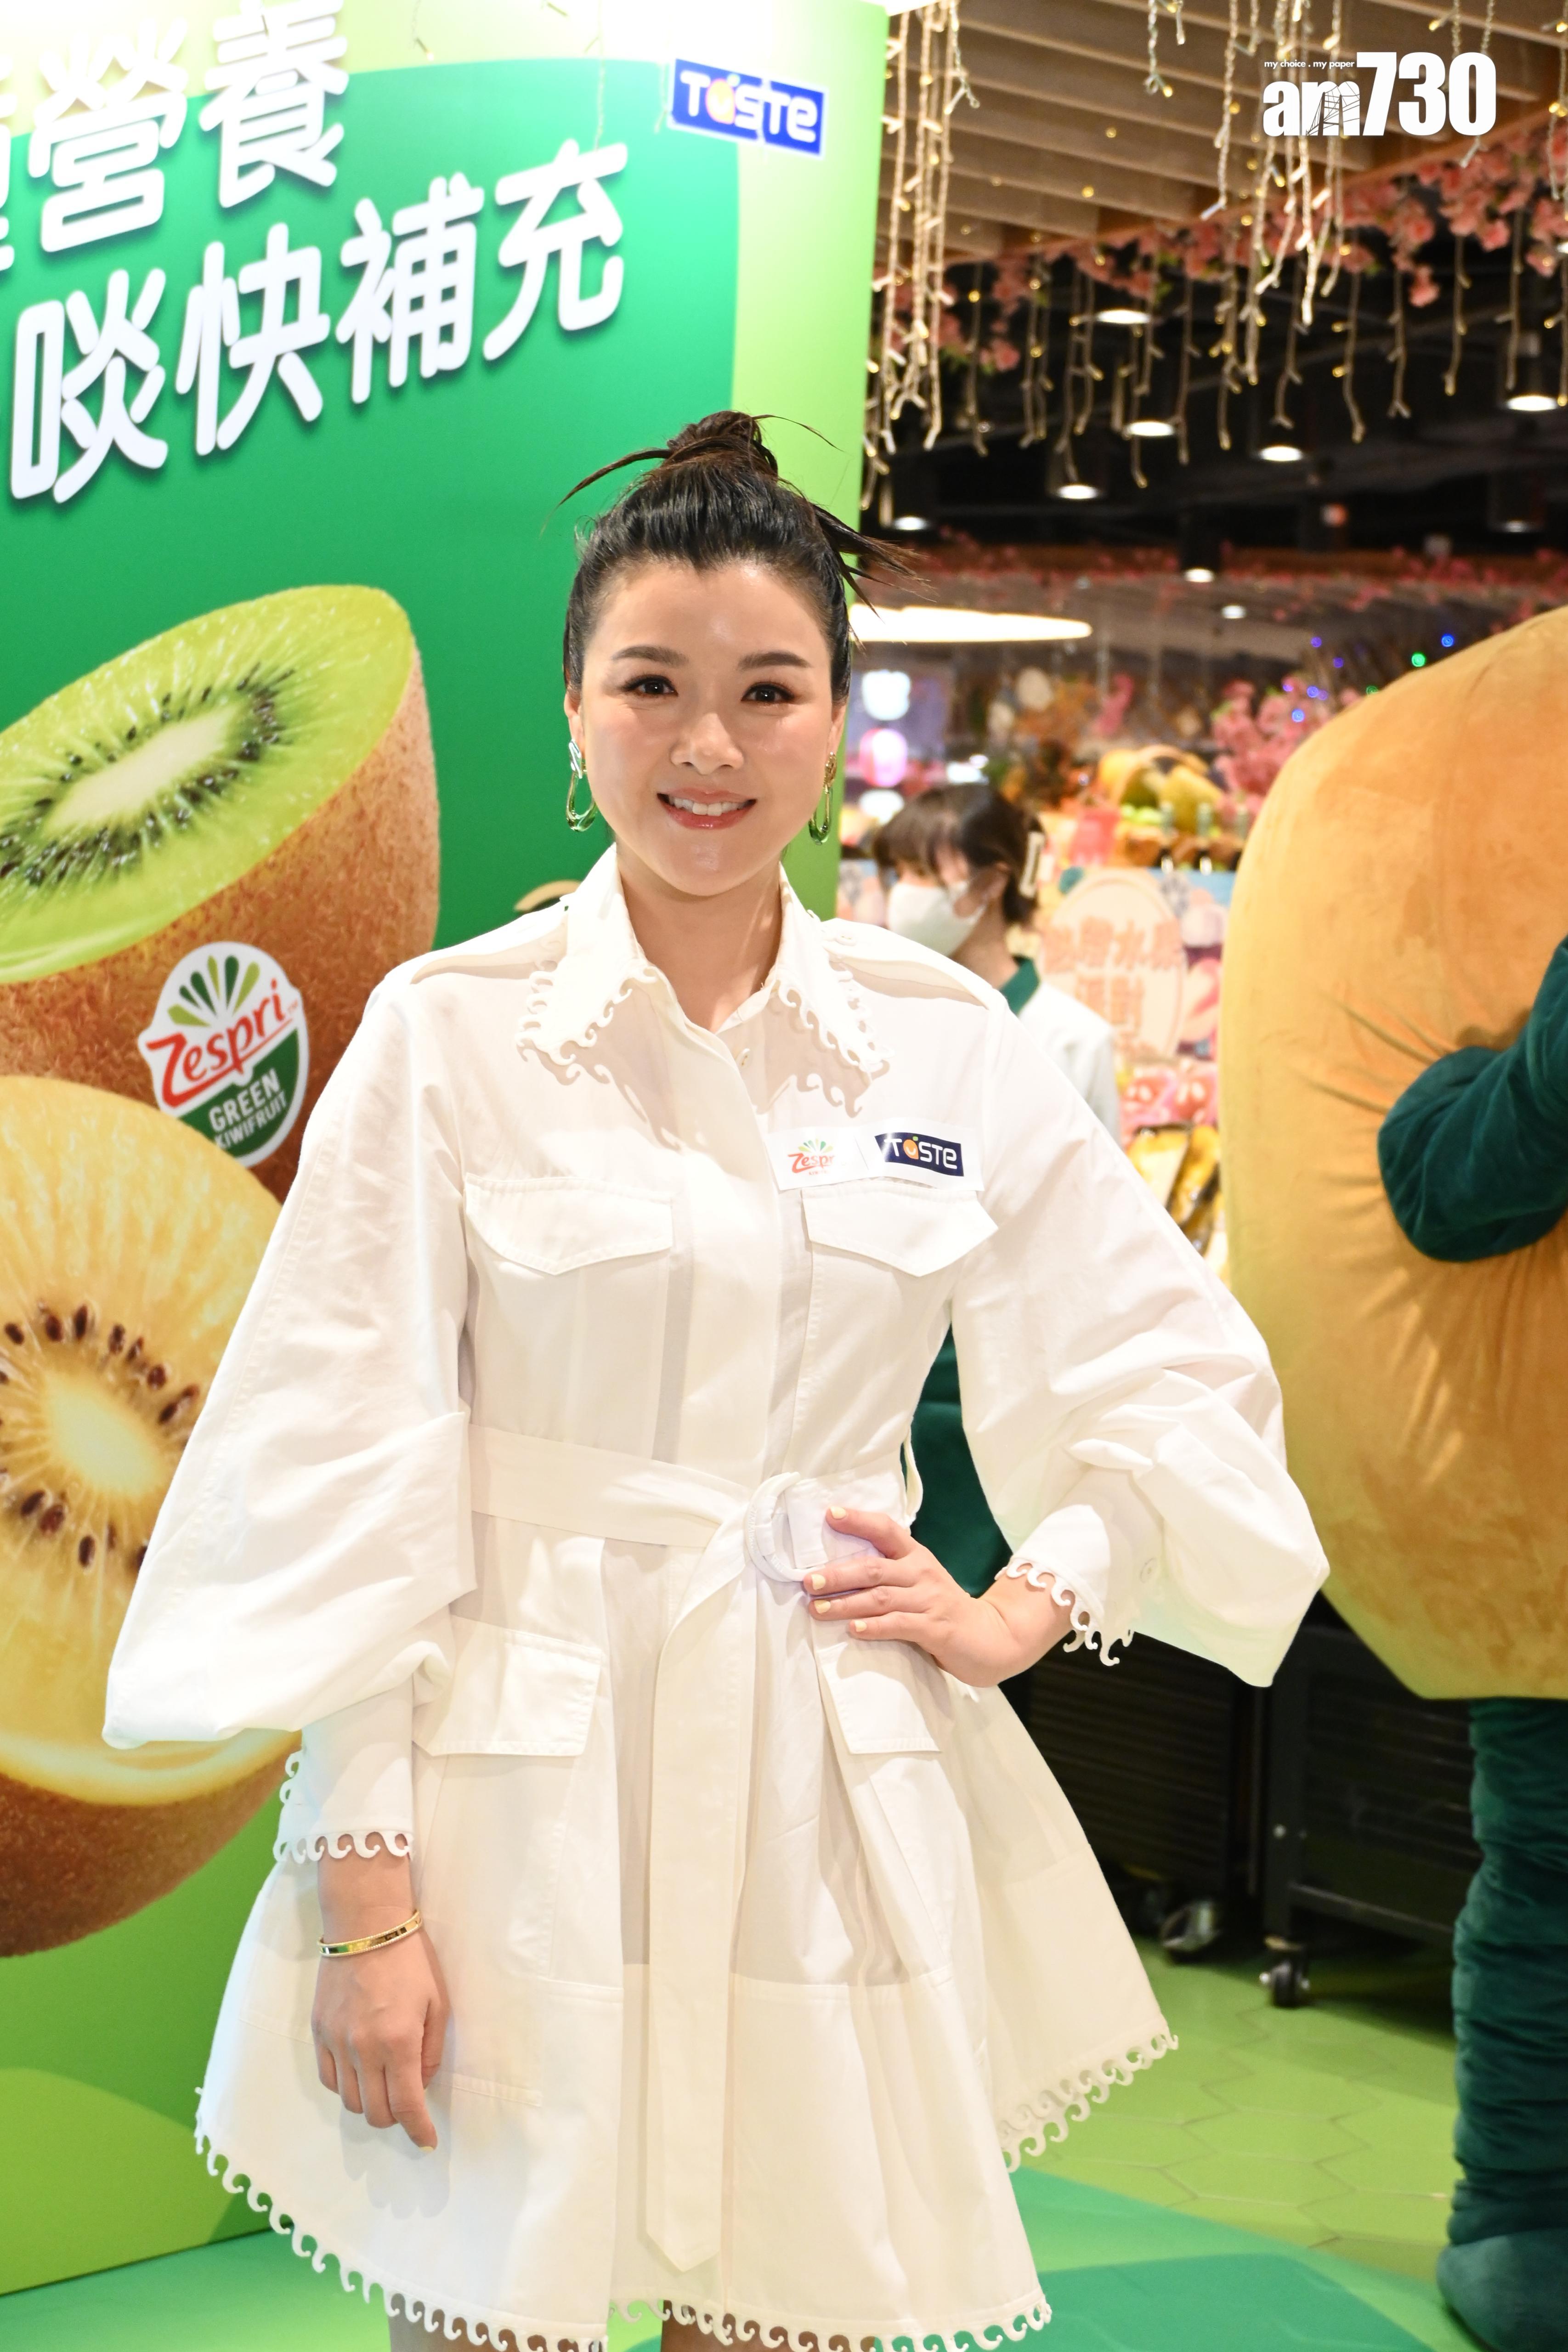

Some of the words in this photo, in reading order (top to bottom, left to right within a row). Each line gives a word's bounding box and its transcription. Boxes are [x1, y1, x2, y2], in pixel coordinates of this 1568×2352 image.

[0, 0, 349, 272] 營養
[11, 138, 628, 503] 啖快補充
[146, 978, 293, 1108] Zespri
[208, 1068, 281, 1132] GREEN
[214, 1091, 287, 1148] KIWIFRUIT
[787, 1153, 836, 1174] Zespr
